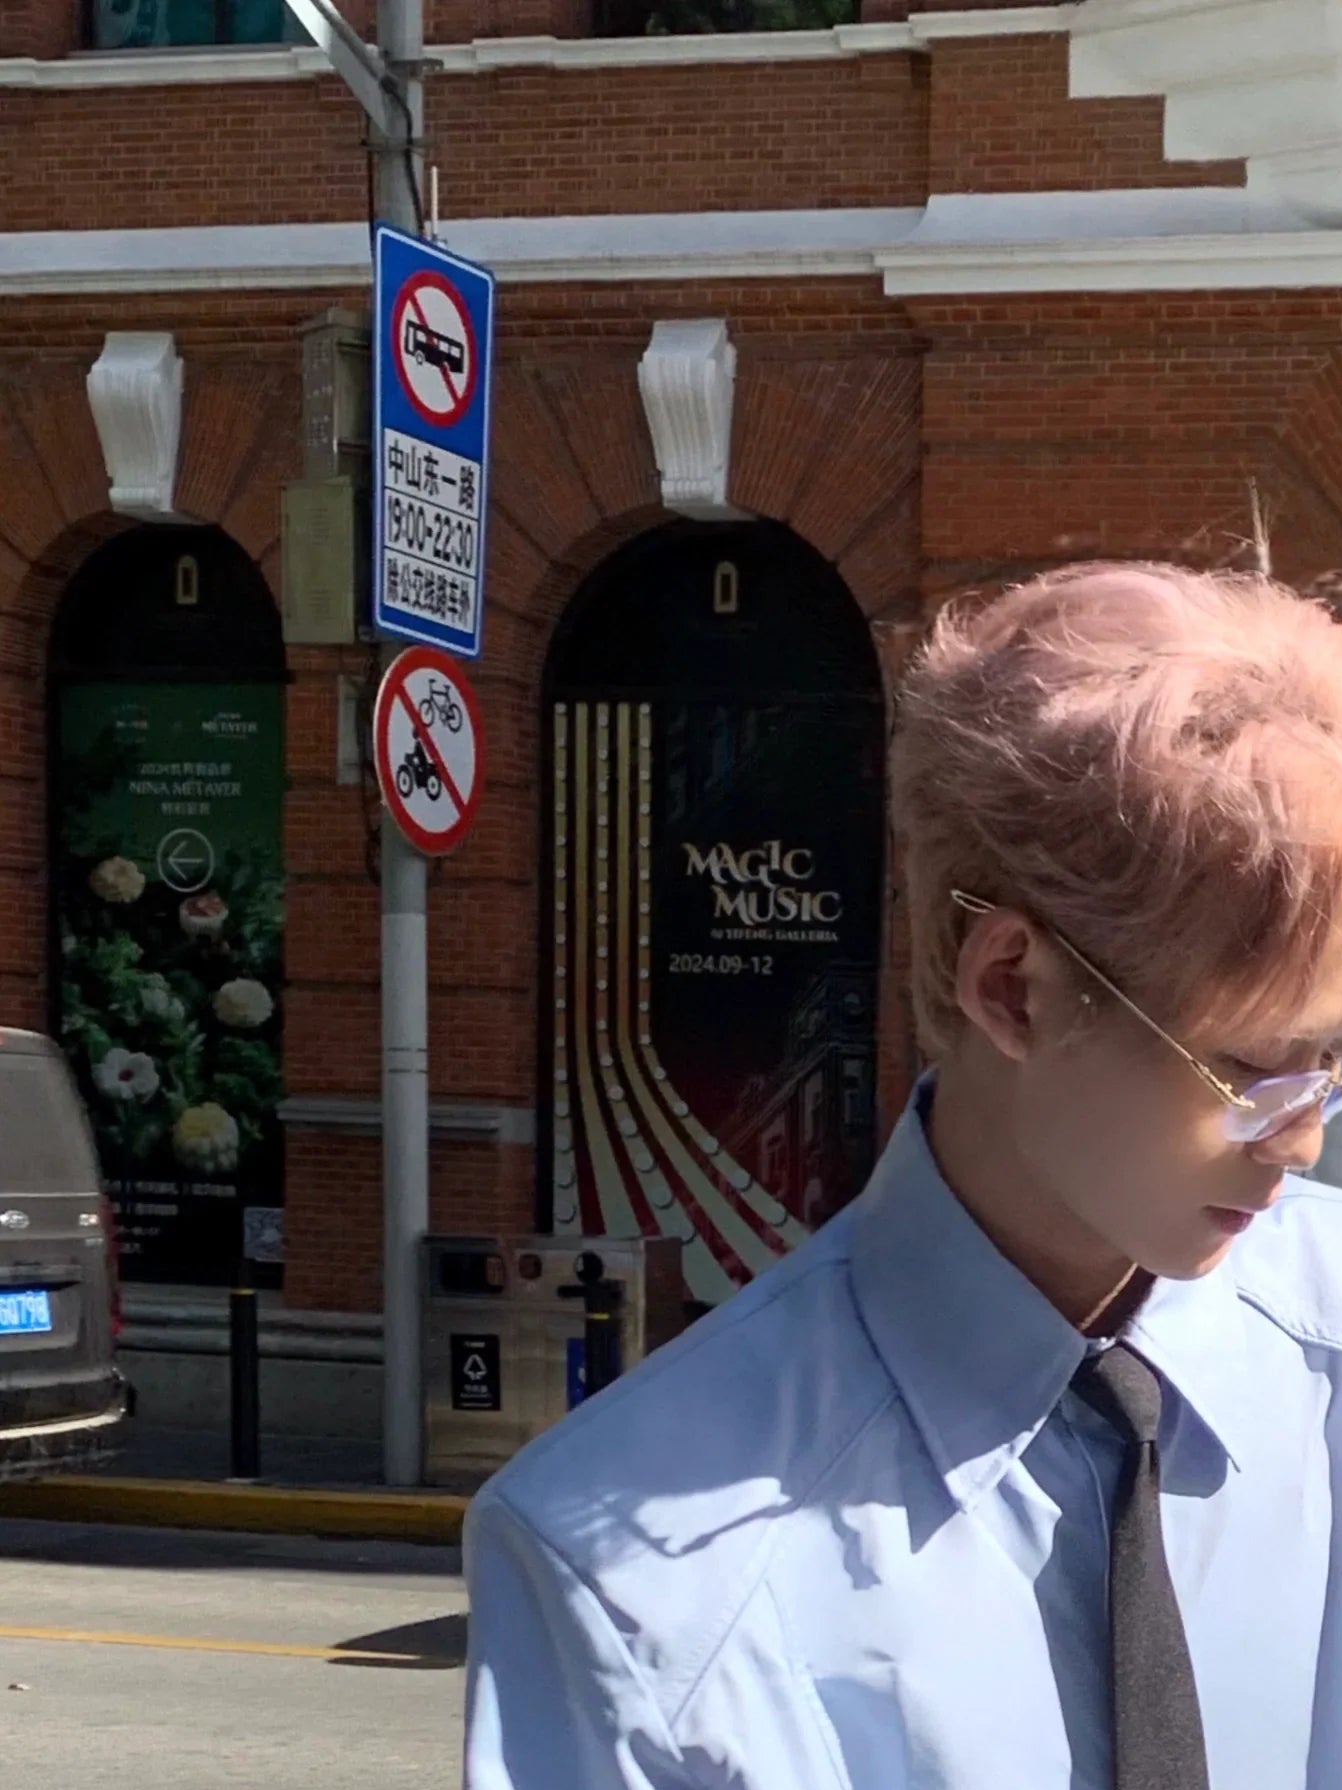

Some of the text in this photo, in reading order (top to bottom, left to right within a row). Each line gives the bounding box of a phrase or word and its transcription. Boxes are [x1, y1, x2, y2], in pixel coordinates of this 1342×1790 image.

[388, 438, 476, 513] 中山东一路
[387, 495, 474, 570] 19:00-22:30
[682, 840, 814, 888] MAGIC
[712, 885, 842, 925] MUSIC
[669, 954, 774, 975] 2024.09-12
